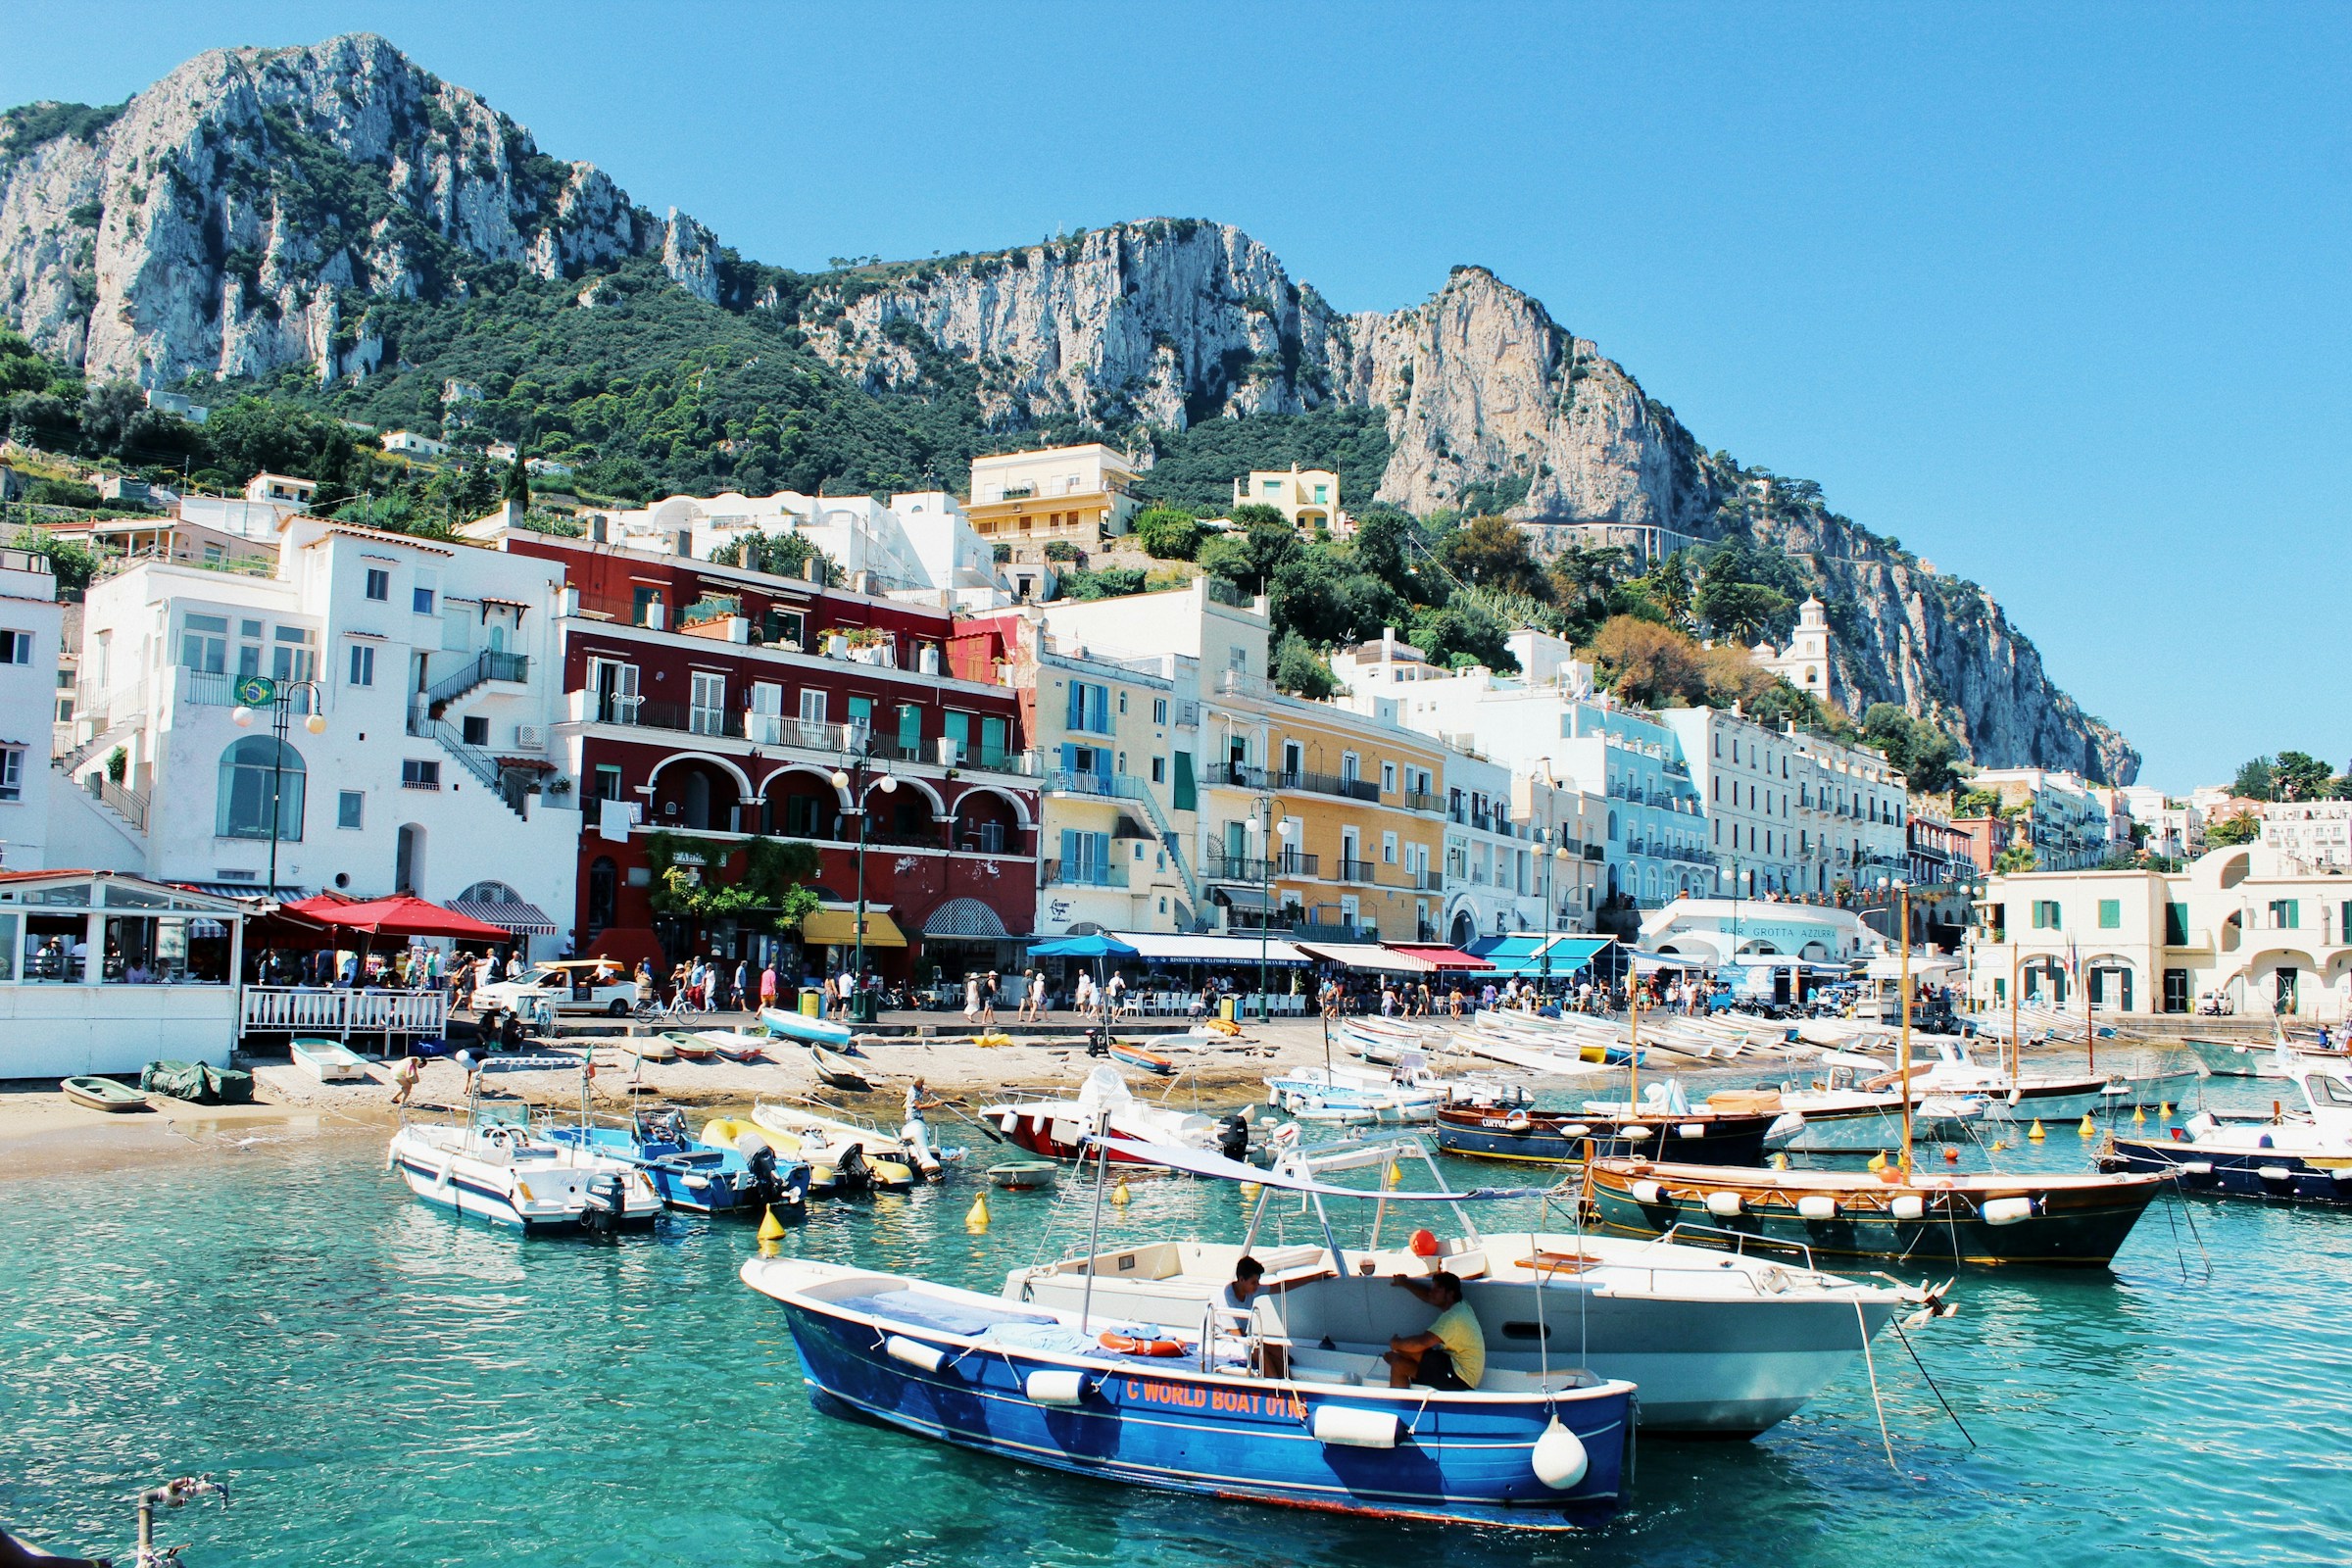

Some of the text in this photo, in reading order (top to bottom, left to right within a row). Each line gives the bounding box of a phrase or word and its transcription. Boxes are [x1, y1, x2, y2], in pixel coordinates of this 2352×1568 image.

[1720, 927, 1836, 938] BAR GROTTA AZZURRA
[591, 1184, 612, 1196] SELVA
[1127, 1377, 1139, 1399] C
[1144, 1380, 1206, 1408] WORLD
[1211, 1387, 1261, 1414] BOAT
